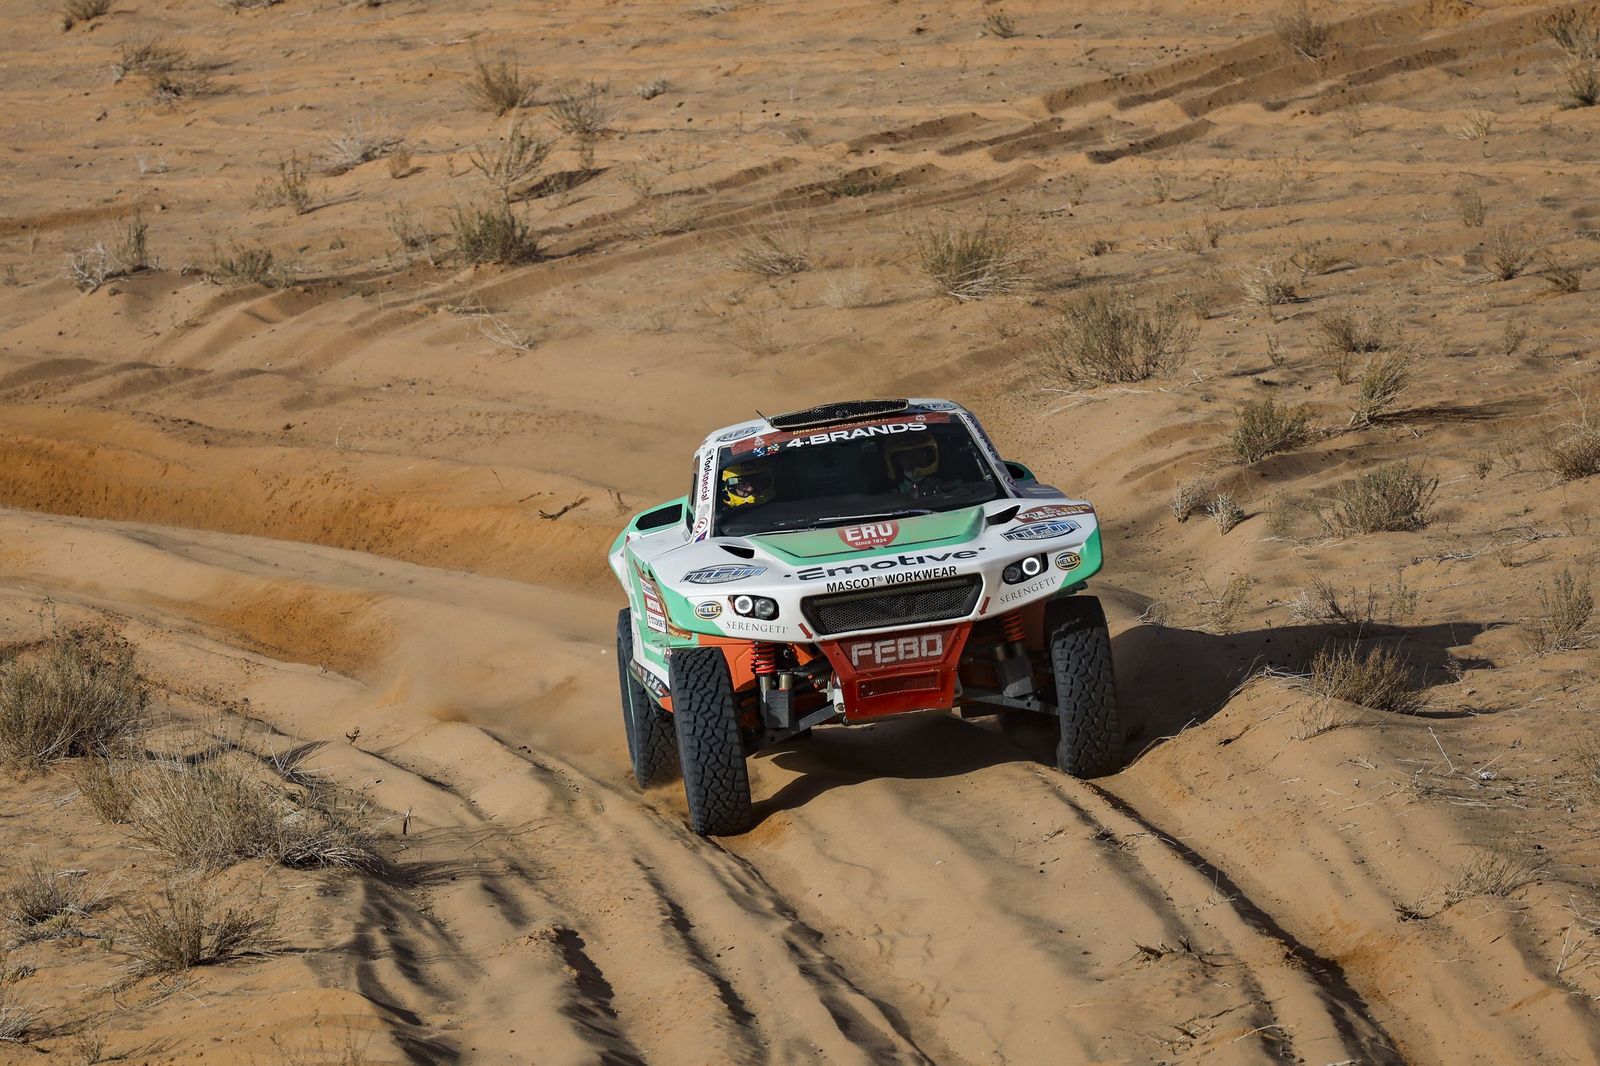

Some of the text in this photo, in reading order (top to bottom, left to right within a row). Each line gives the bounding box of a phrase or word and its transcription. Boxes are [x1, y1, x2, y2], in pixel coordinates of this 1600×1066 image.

[700, 454, 714, 502] Toolspecial
[844, 521, 893, 542] ERU
[855, 539, 872, 547] Since
[797, 550, 978, 581] Emotive
[1058, 556, 1081, 566] HELLA
[884, 565, 957, 583] WORKWEAR
[697, 605, 722, 614] HELLA
[850, 633, 943, 666] FEBO
